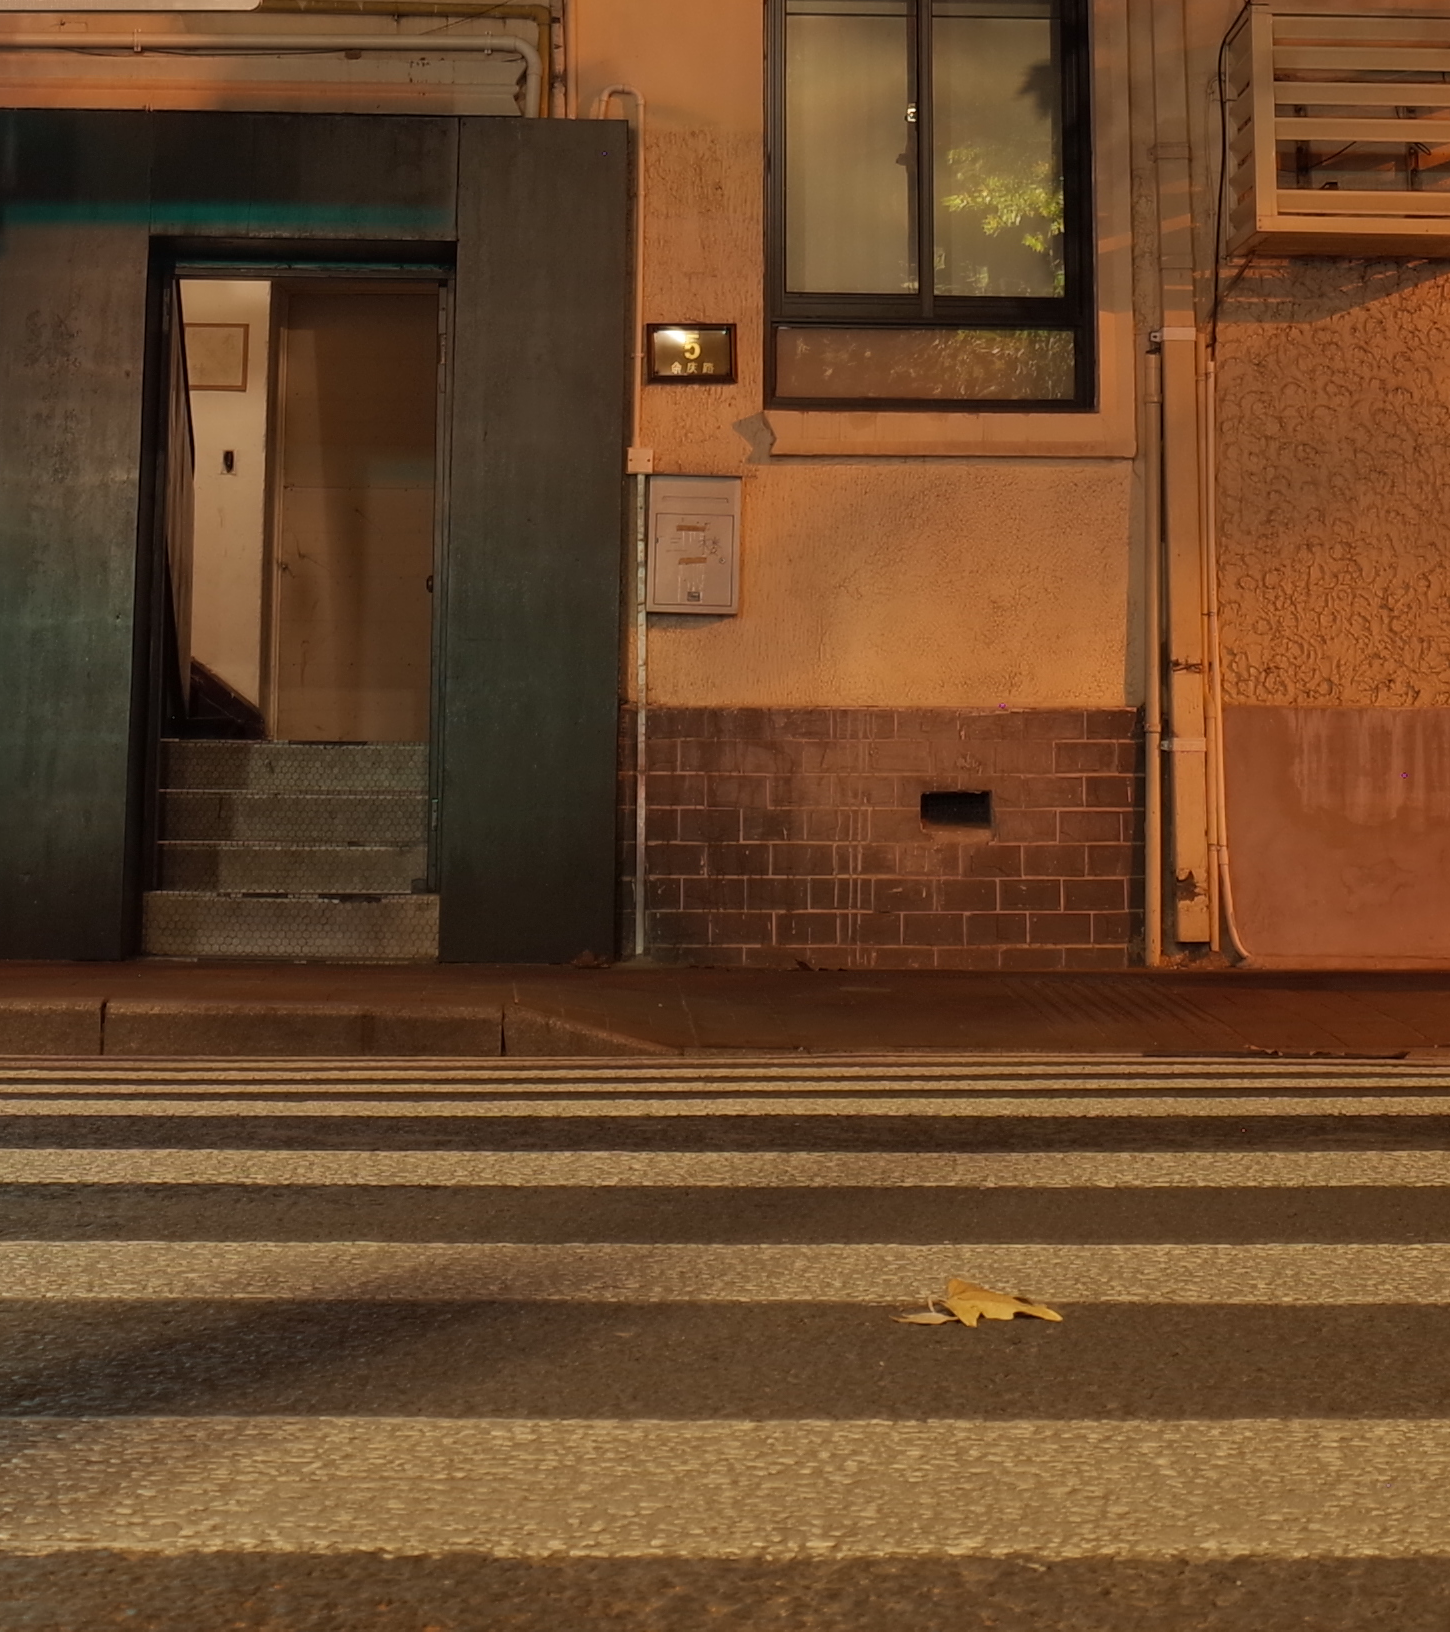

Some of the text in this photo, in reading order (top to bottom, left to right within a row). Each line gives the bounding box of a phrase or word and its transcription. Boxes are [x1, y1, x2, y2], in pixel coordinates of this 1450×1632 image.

[684, 334, 701, 360] 5
[671, 361, 714, 375] 余庆路
